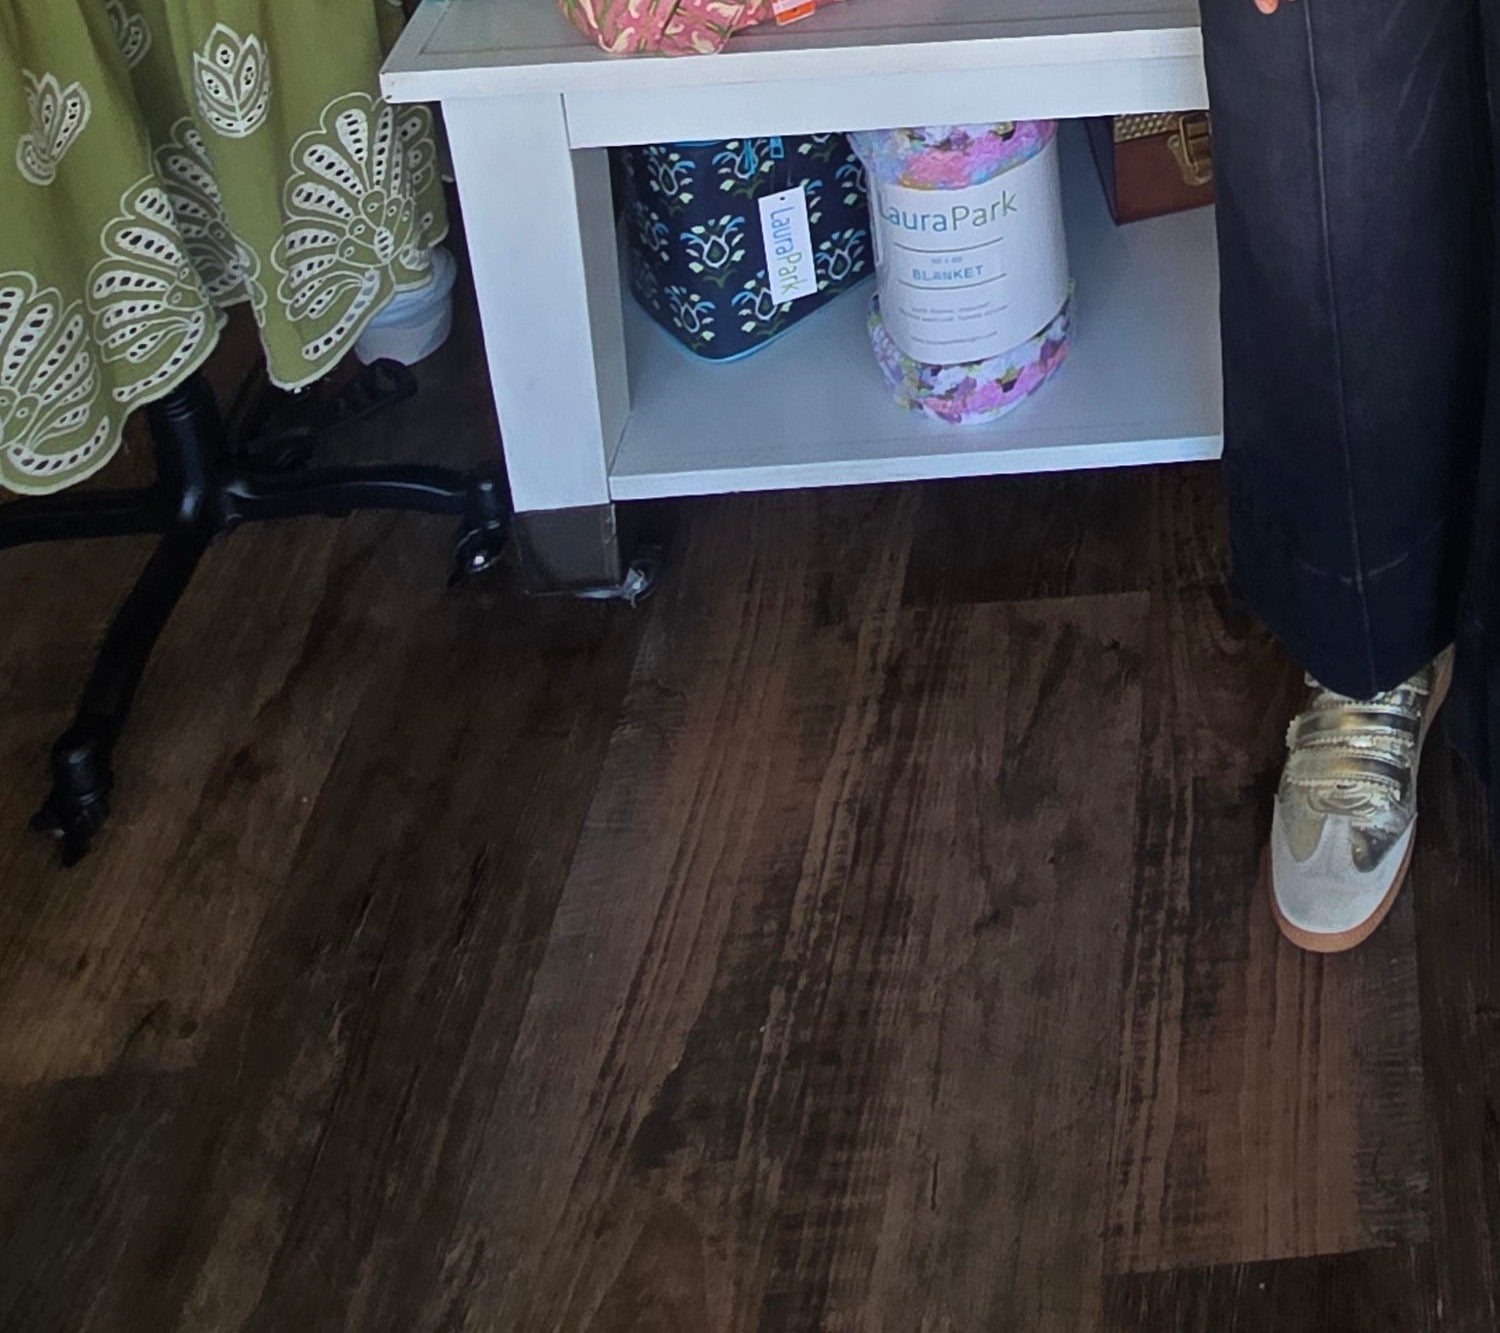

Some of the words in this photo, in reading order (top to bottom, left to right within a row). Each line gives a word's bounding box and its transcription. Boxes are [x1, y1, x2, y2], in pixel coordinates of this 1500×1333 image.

[877, 190, 1018, 232] LauraPark
[769, 206, 809, 295] LauraPark
[912, 265, 984, 281] BLANKET
